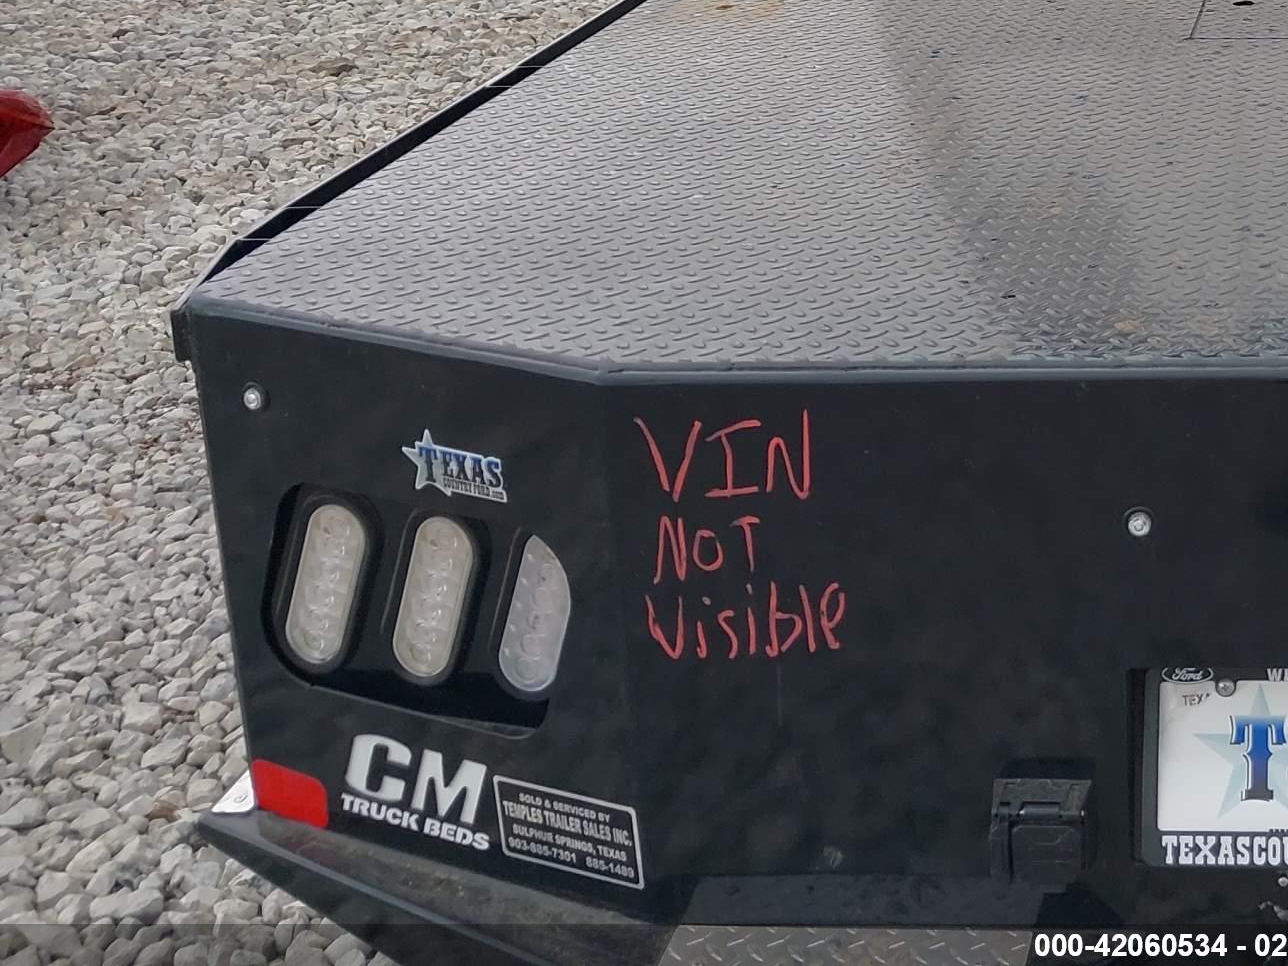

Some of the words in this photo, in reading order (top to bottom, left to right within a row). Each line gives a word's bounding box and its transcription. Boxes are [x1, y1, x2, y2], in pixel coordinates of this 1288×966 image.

[418, 445, 503, 489] TEXAS
[633, 409, 811, 503] VIN
[1171, 667, 1203, 681] Ford
[344, 733, 488, 826] CM
[340, 792, 421, 832] TRUCK
[422, 817, 491, 851] BEDS
[502, 800, 544, 824] TEMPLES
[543, 810, 582, 834] TRAILER
[582, 819, 612, 842] SALES
[518, 792, 543, 807] SOLD
[552, 800, 597, 820] SERVICED
[597, 811, 611, 823] BY
[512, 823, 554, 844] SULPHUR
[596, 845, 627, 862] TEXAS
